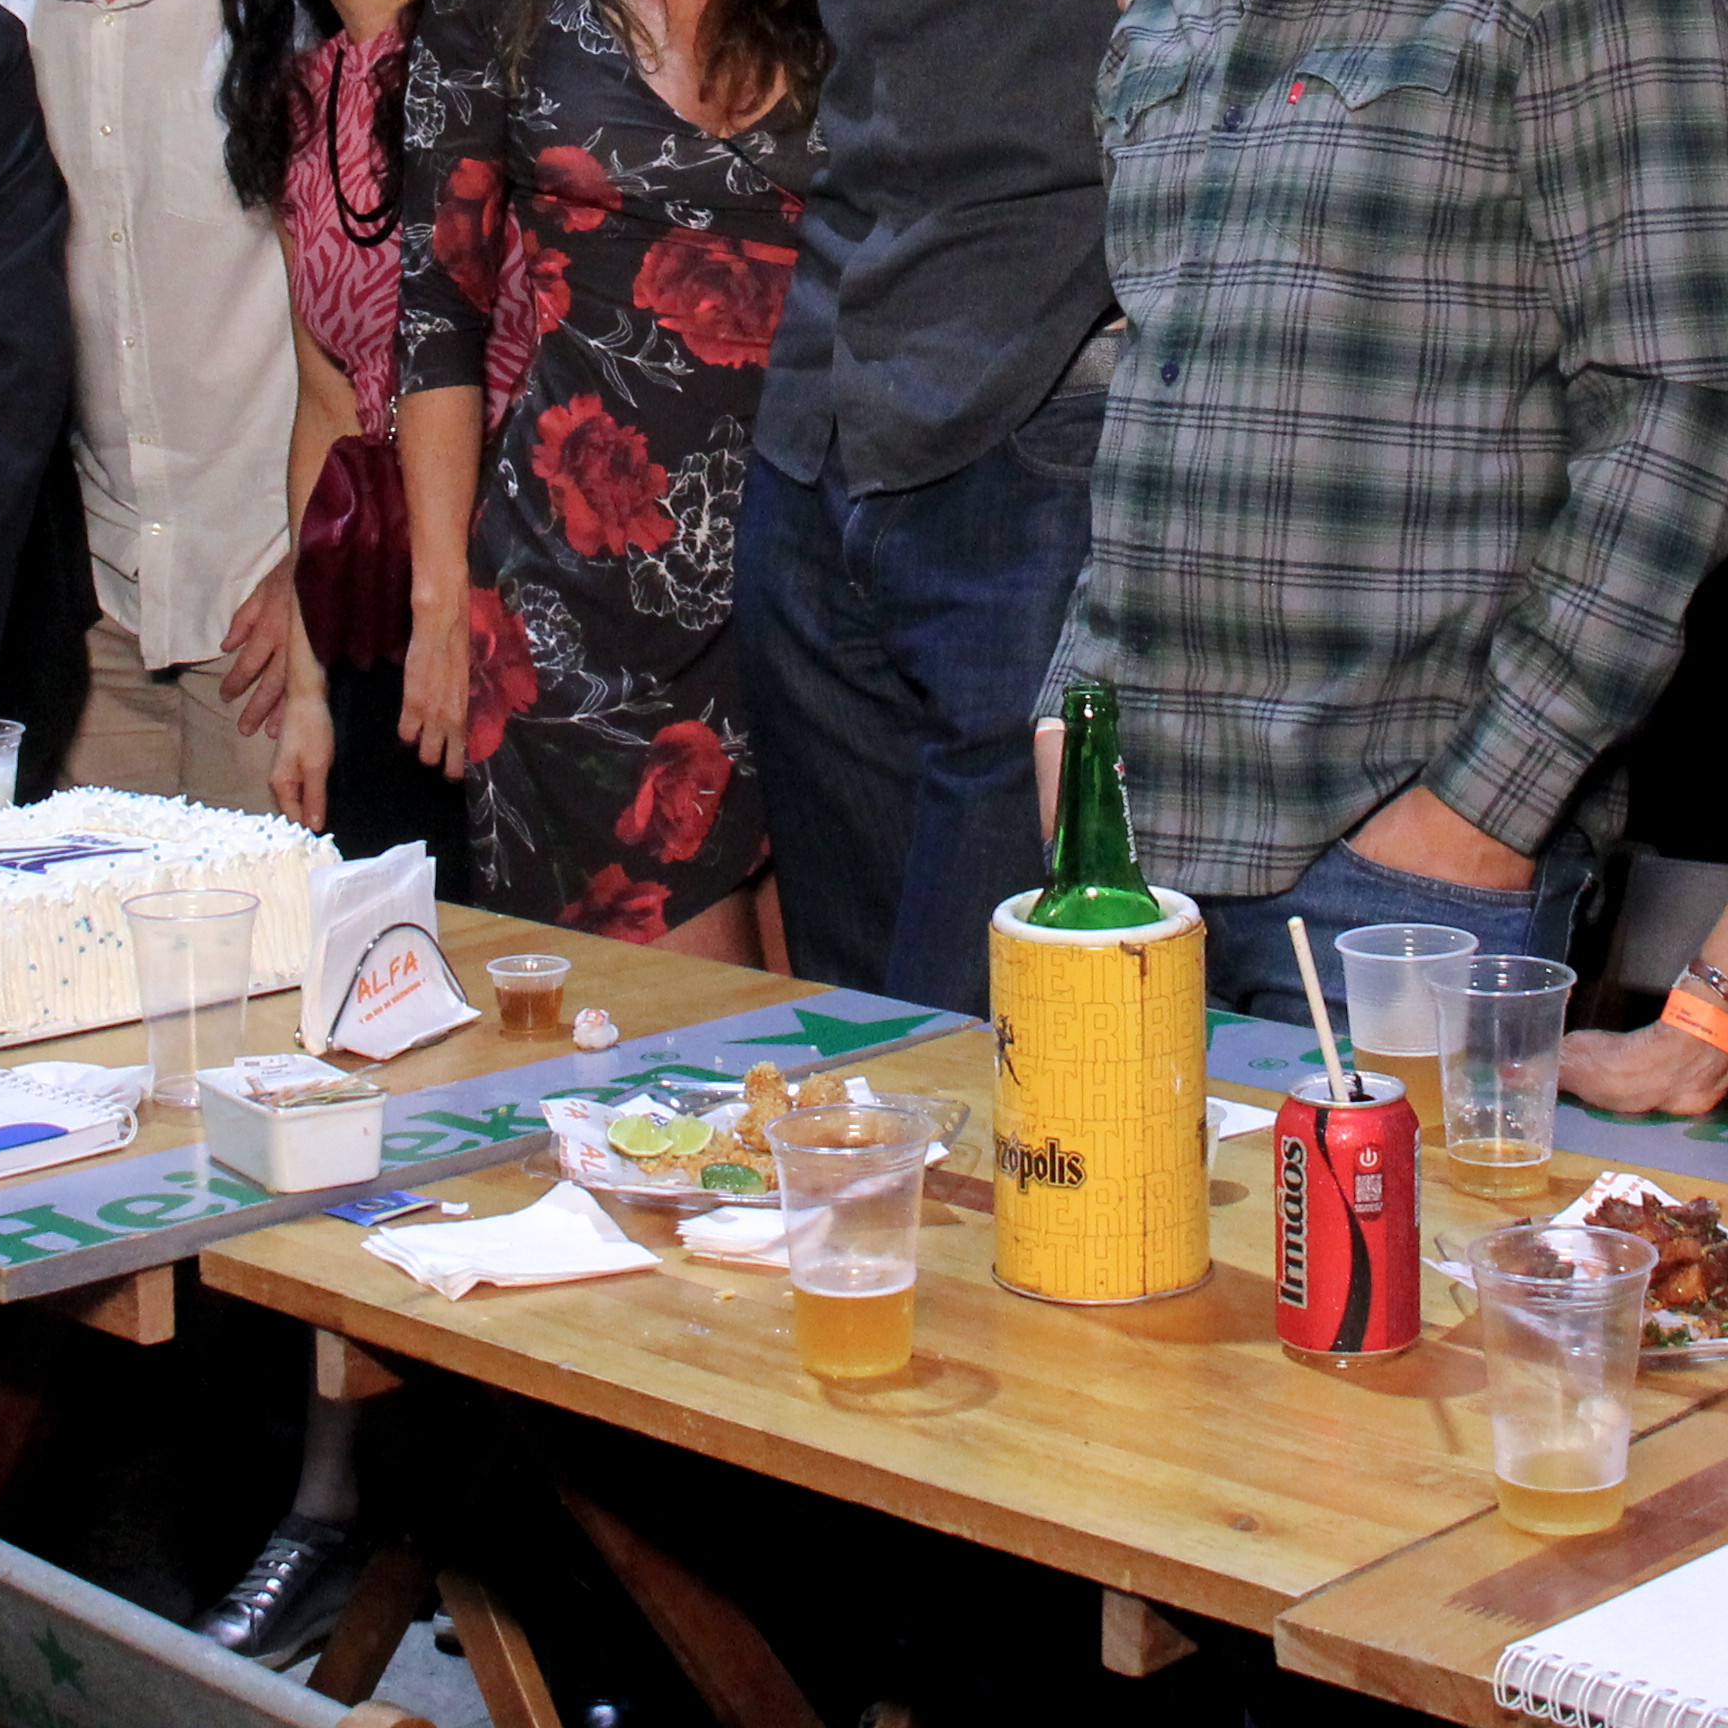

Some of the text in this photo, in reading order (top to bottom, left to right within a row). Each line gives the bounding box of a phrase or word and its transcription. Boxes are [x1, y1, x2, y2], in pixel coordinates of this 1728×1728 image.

[357, 949, 420, 1006] ALFA
[994, 1130, 1087, 1194] zópolis
[1279, 1134, 1309, 1310] Irmãos
